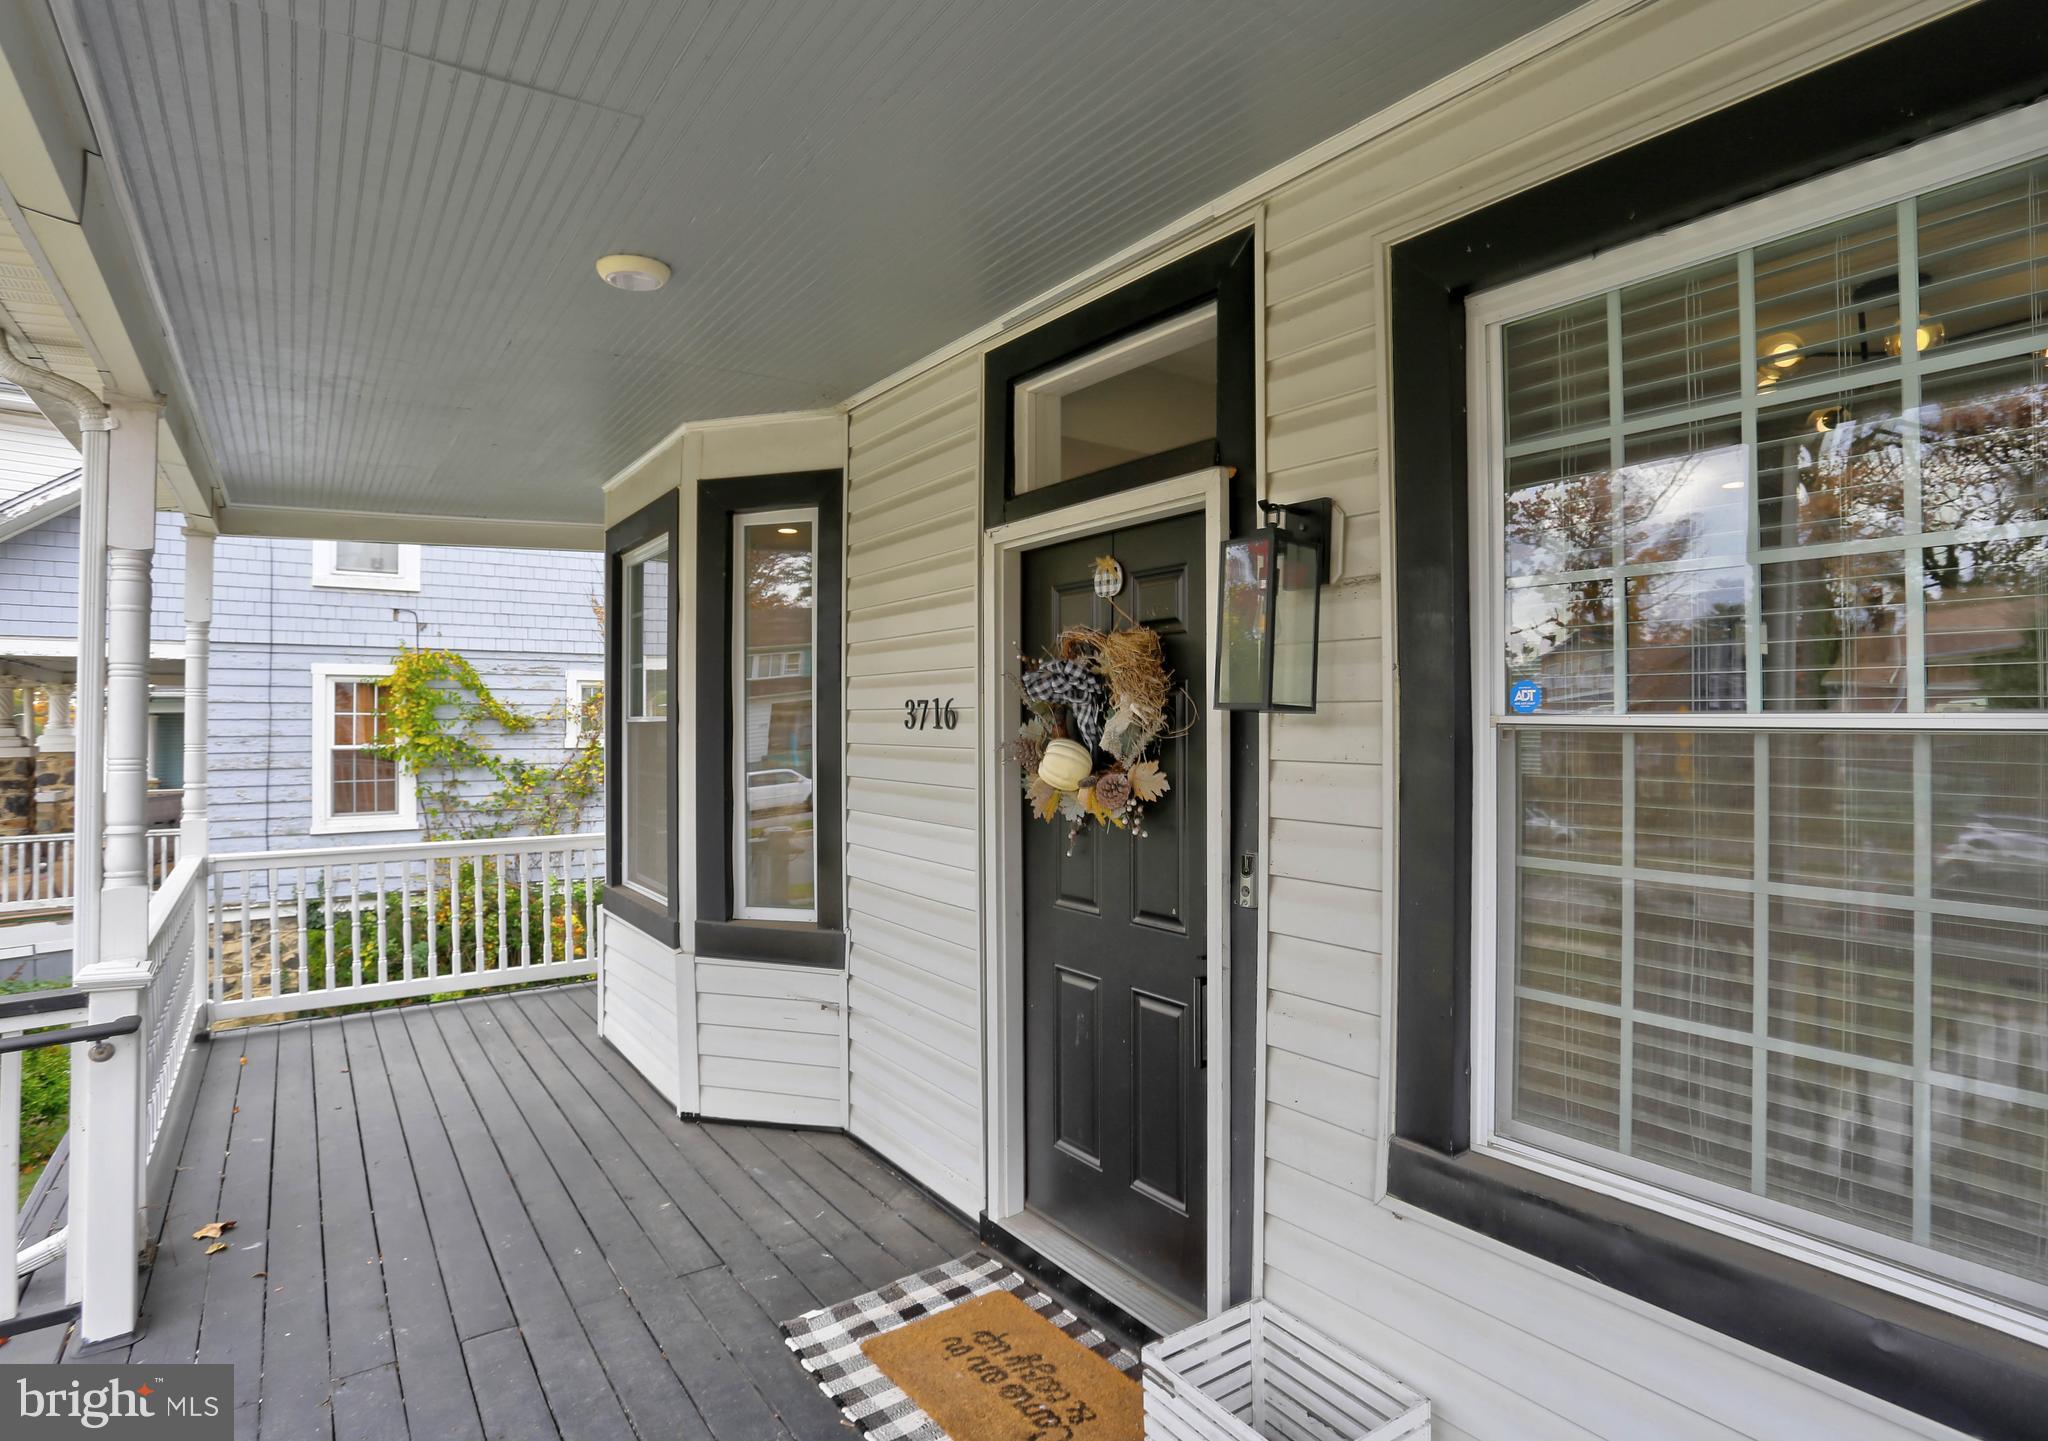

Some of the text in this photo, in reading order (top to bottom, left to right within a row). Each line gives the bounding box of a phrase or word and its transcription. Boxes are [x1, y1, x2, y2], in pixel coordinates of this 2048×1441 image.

[1514, 689, 1537, 702] ADT
[904, 697, 958, 731] 3716
[942, 1336, 975, 1361] in
[972, 1330, 1012, 1356] up
[967, 1355, 1009, 1385] on
